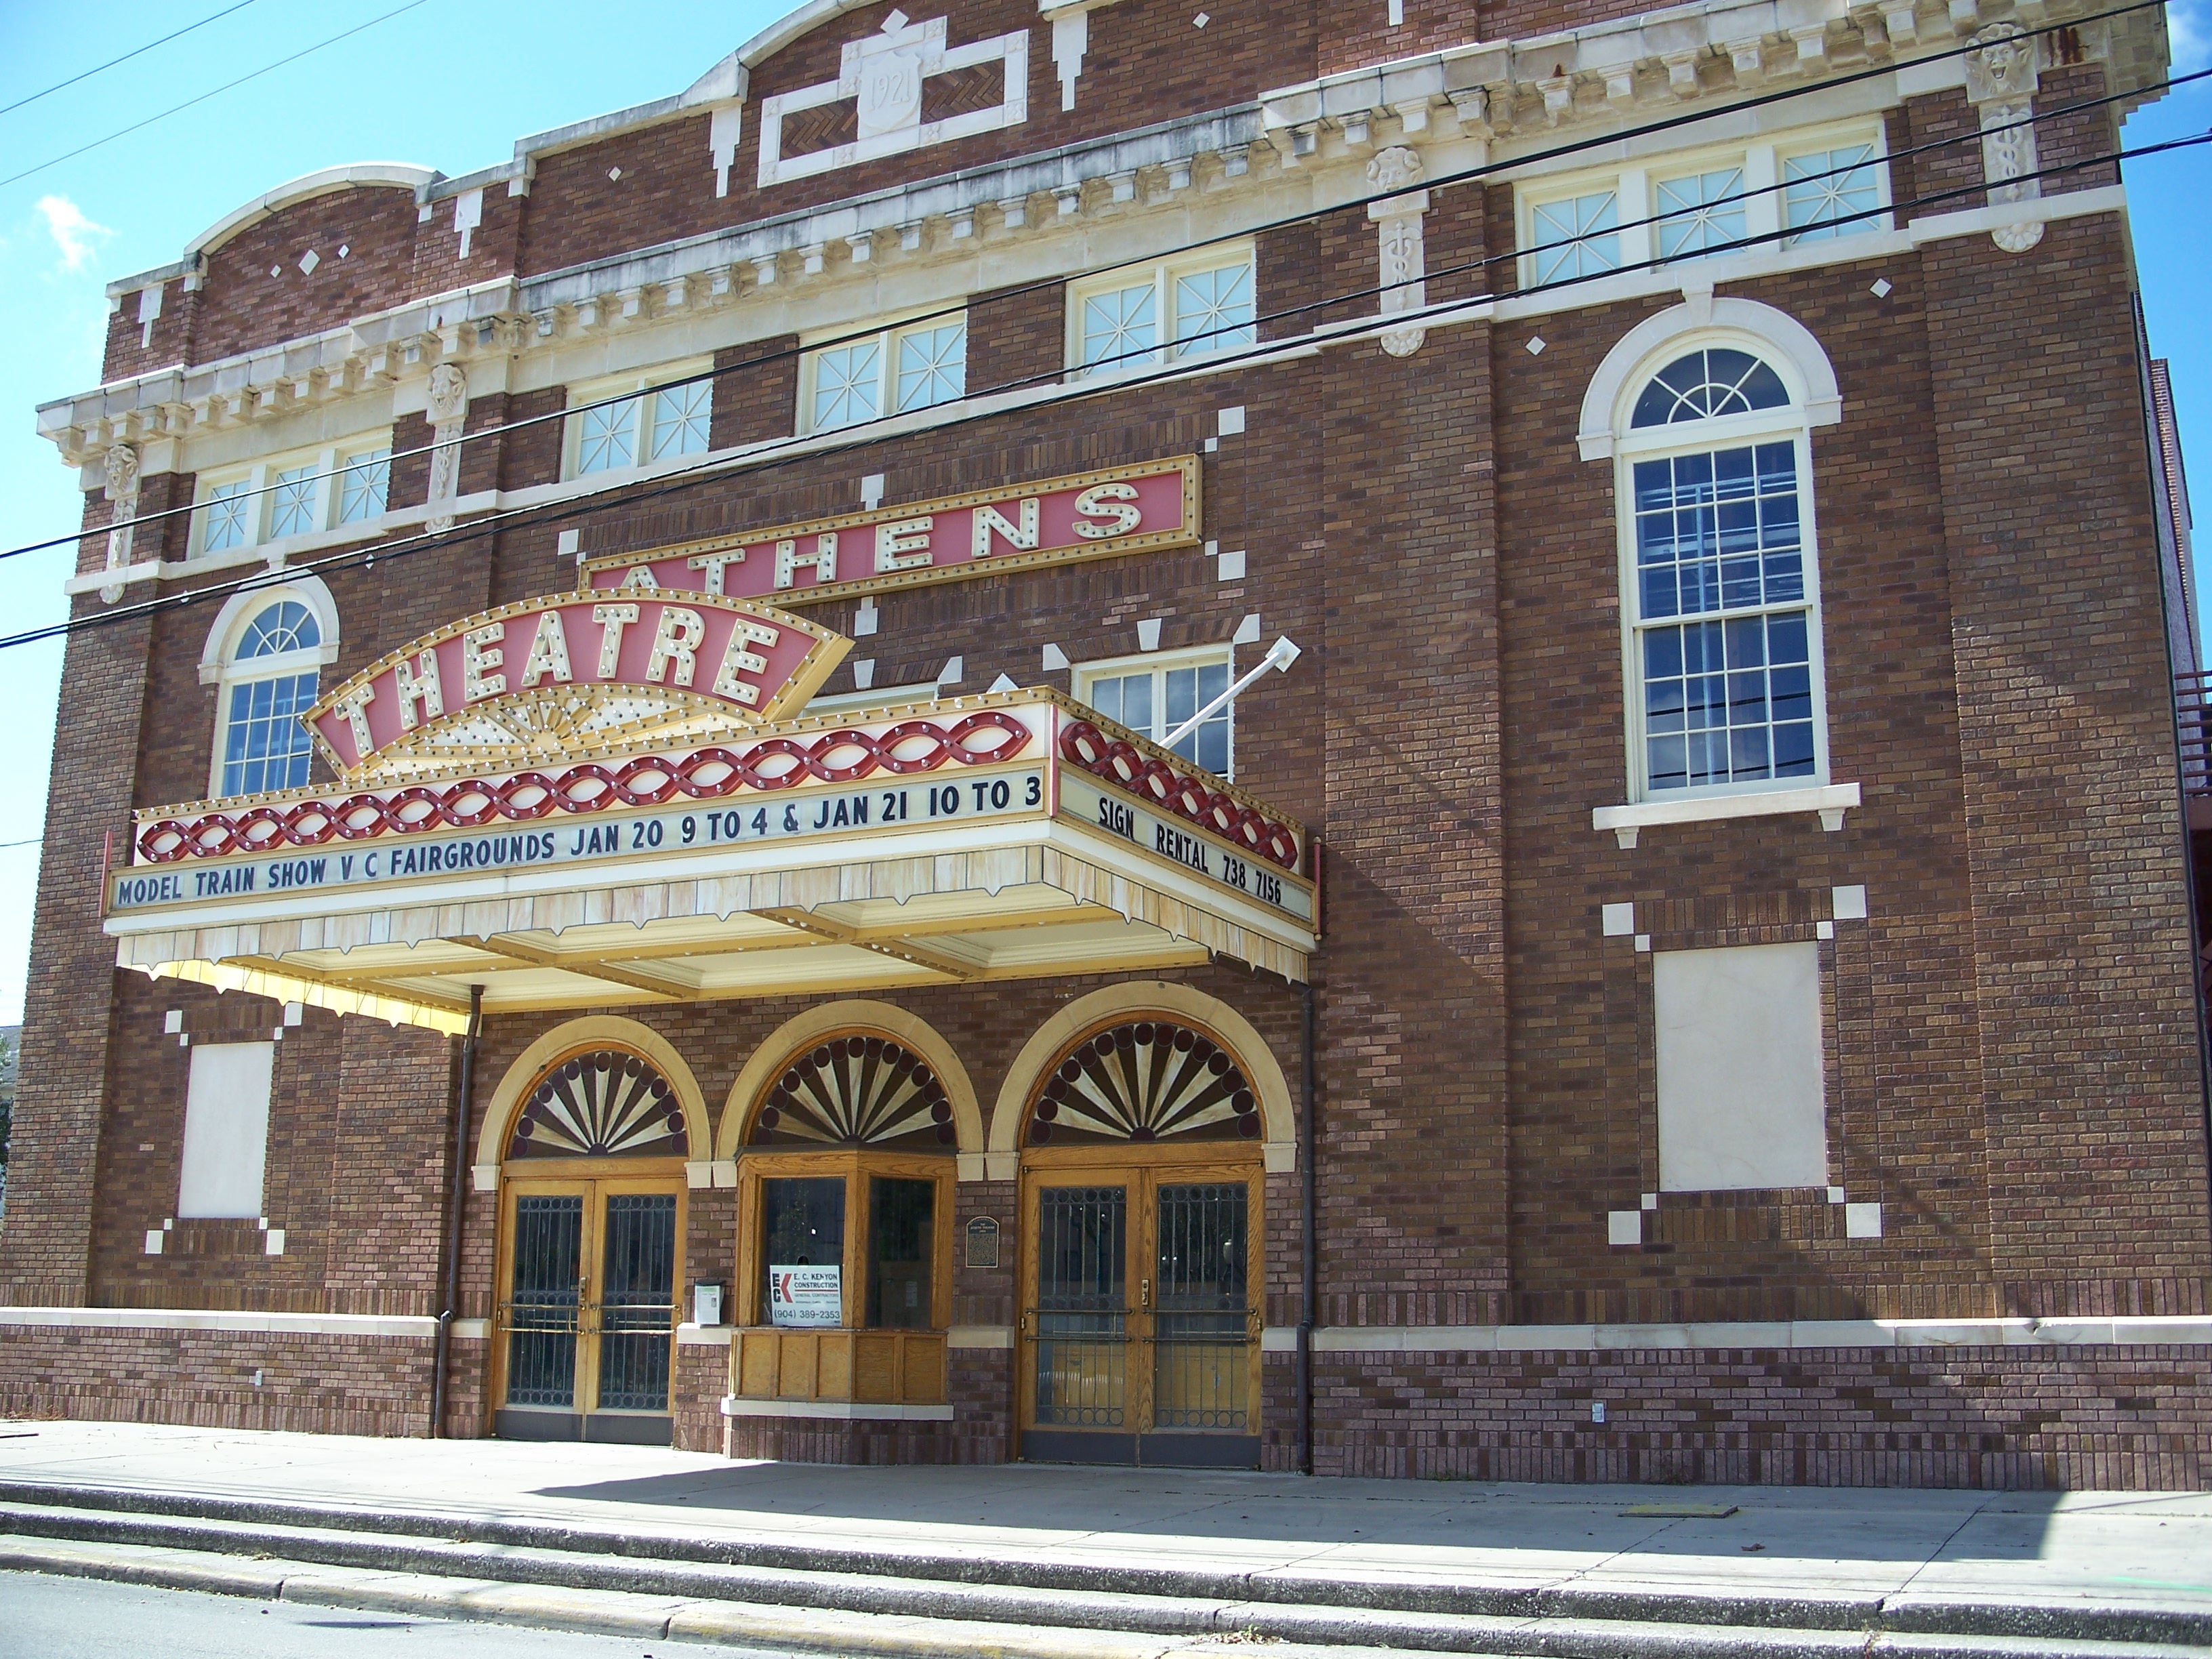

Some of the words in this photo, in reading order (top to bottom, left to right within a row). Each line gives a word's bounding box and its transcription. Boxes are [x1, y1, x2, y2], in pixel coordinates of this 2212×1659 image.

[868, 68, 911, 112] 1921
[333, 602, 779, 758] THEATRE
[118, 875, 182, 905] MODEL
[195, 866, 255, 897] TRAIN
[268, 858, 327, 888] SHOW
[340, 853, 353, 881] V
[364, 851, 378, 879] C
[390, 833, 555, 876] FAIRGROUNDS
[570, 824, 619, 857] JAN
[632, 820, 663, 848] 20
[681, 815, 695, 844] 9
[707, 810, 741, 841] TO
[751, 807, 768, 836] 4
[783, 803, 800, 832] &
[813, 795, 869, 830] JAN
[882, 792, 907, 821] 21
[972, 779, 1010, 811] TO
[1025, 776, 1041, 806] 3
[1099, 796, 1134, 841] SIGN
[1156, 823, 1208, 874] RENTAL
[1223, 855, 1246, 889] 738
[1256, 871, 1282, 905] 7156
[774, 1309, 796, 1319] (904)
[800, 1309, 840, 1319] 389-2353
